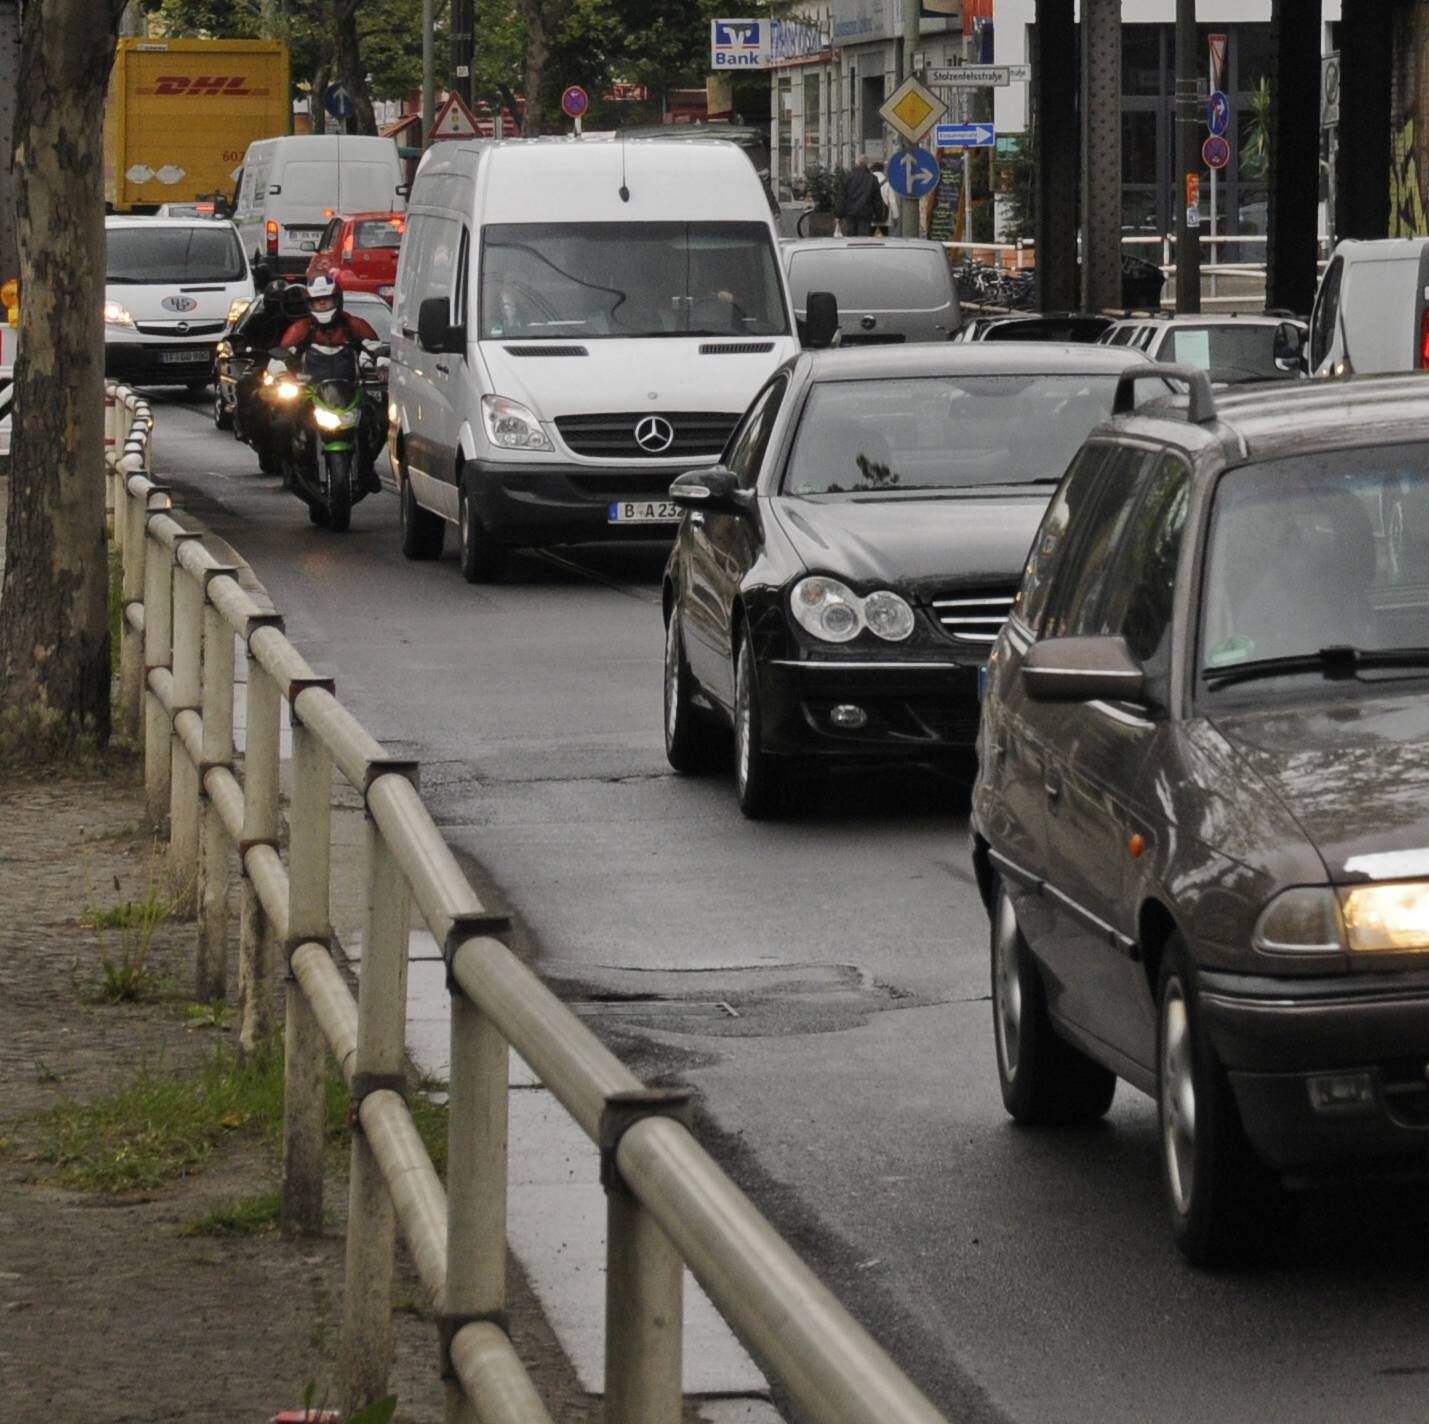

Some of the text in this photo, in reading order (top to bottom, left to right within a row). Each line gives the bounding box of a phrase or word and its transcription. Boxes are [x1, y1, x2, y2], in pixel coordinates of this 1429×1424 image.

[715, 52, 760, 65] Bank
[153, 76, 250, 97] DHL
[624, 503, 635, 518] B
